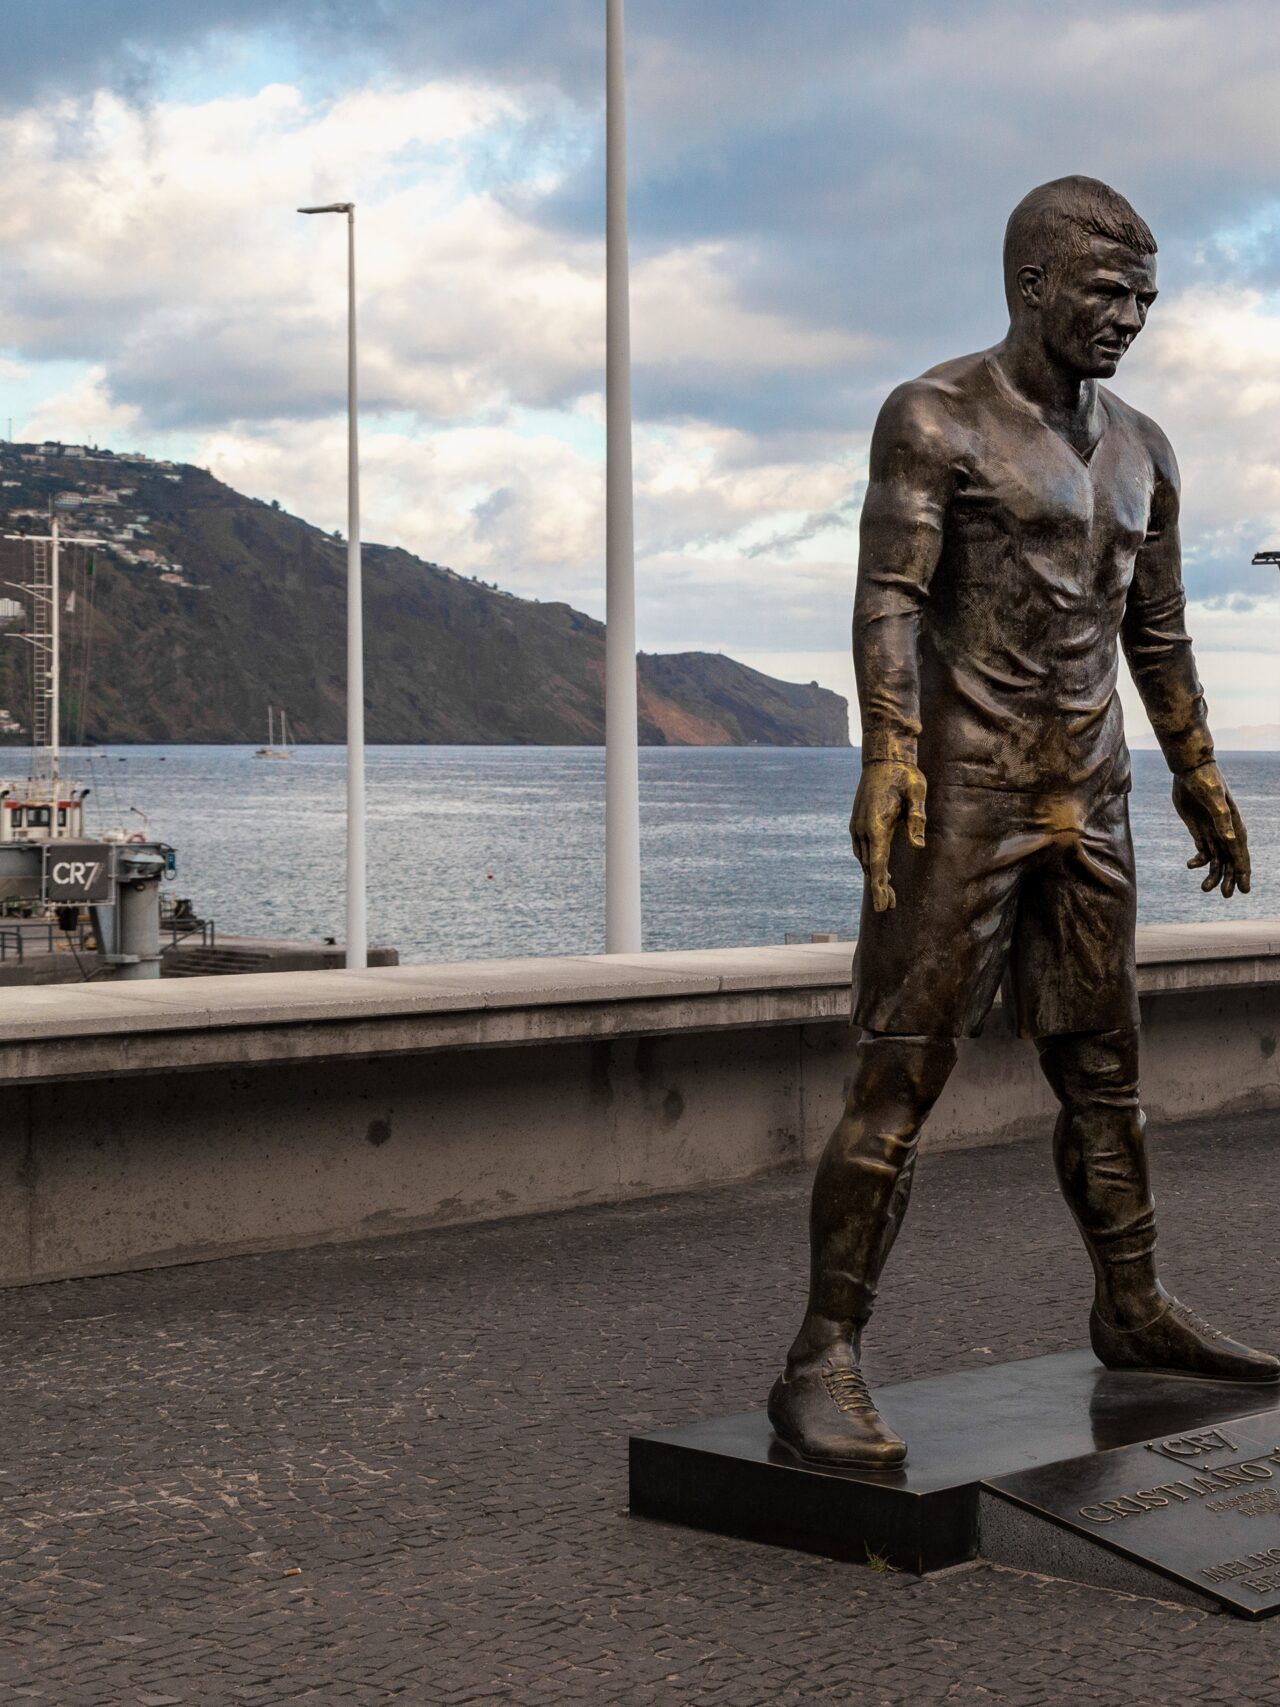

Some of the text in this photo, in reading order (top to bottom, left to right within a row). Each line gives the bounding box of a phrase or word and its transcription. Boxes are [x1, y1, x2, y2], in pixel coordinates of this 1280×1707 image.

[52, 861, 103, 891] CR7
[1161, 1429, 1238, 1455] CR7
[1079, 1463, 1273, 1522] CRISTIANO
[1206, 1487, 1278, 1512] NASCIDO
